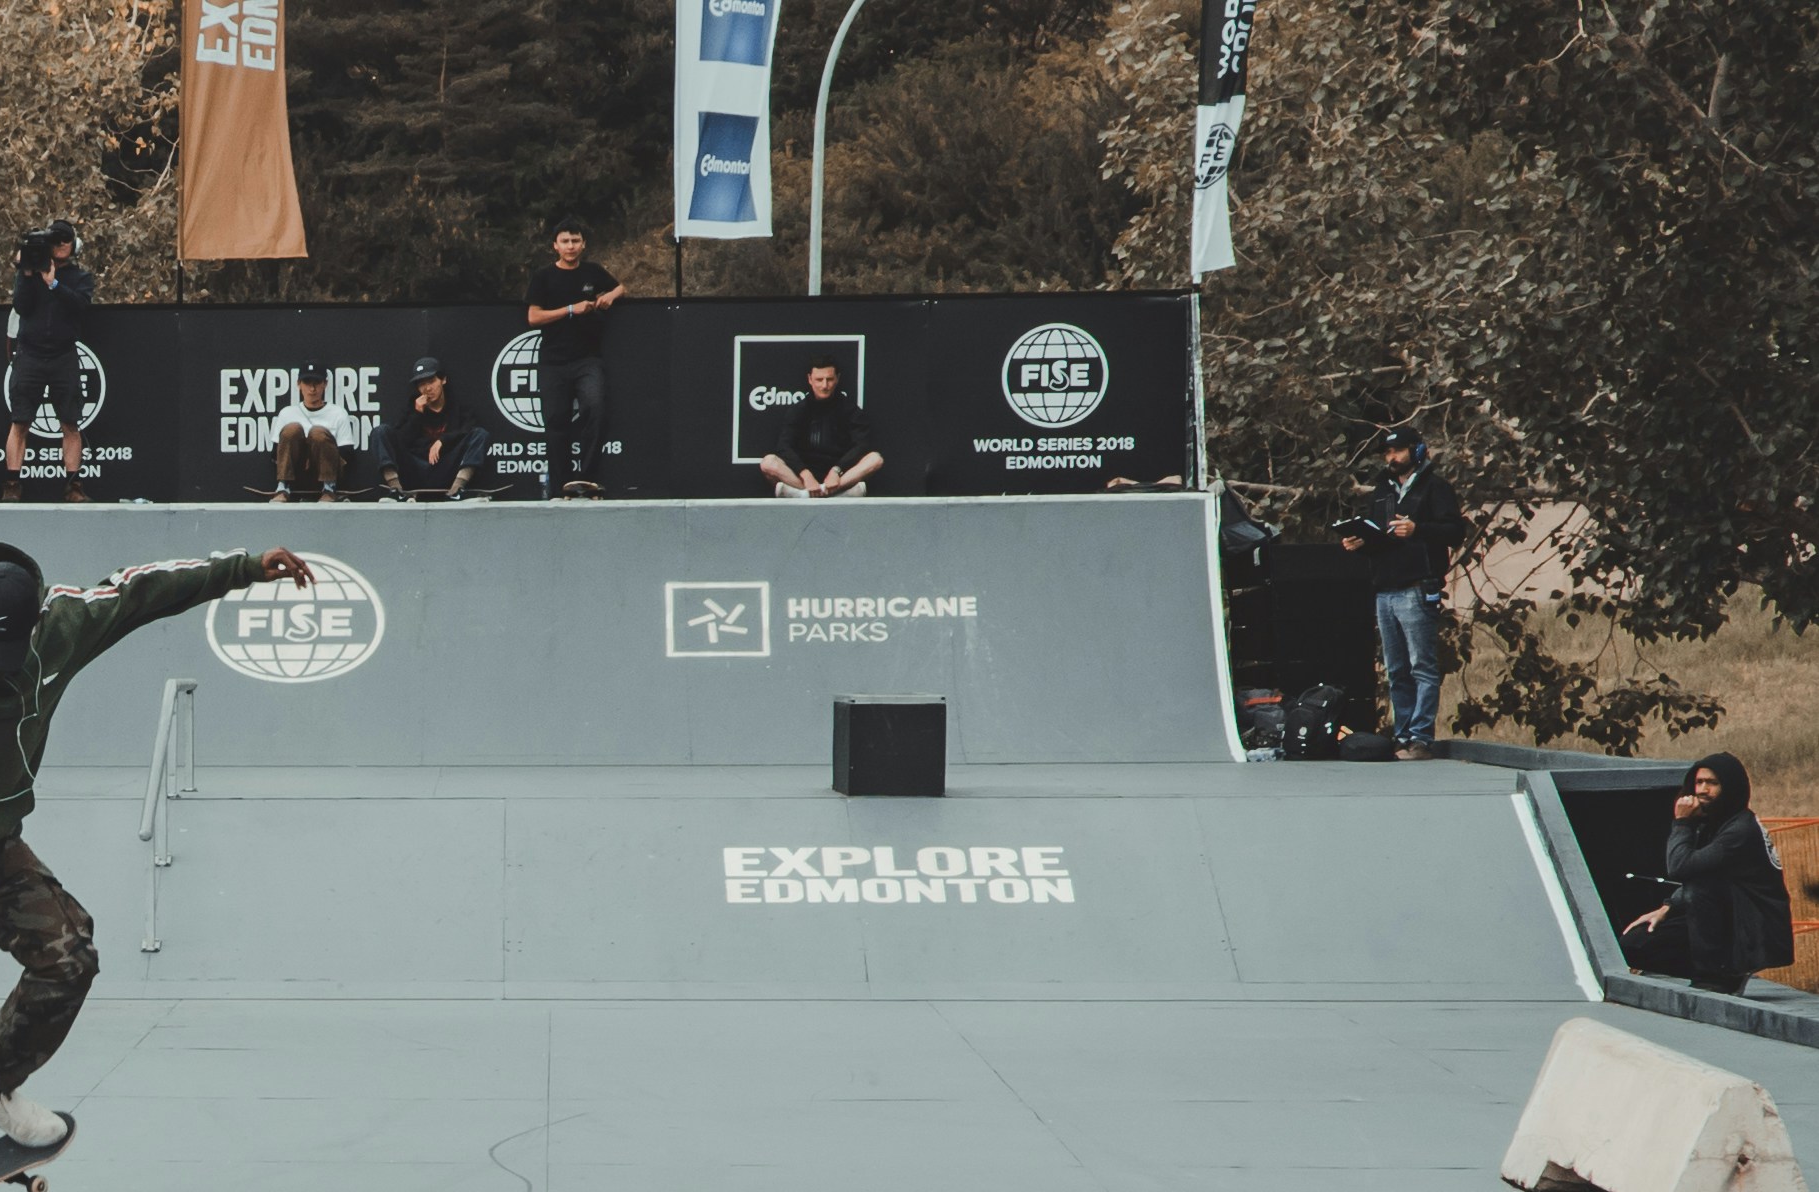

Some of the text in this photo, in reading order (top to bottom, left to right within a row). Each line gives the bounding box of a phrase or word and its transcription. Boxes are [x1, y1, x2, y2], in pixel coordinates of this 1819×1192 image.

[510, 369, 540, 392] FI
[1021, 360, 1090, 391] FISE
[96, 446, 132, 460] 2018
[973, 437, 1135, 452] WORLD SERIES 2018
[19, 465, 101, 479] DMONON
[1006, 455, 1102, 470] EDMONTON
[787, 597, 978, 619] HURRICANE
[238, 603, 353, 642] FISE
[789, 622, 889, 642] PARKS
[723, 846, 1069, 877] EXPLORE
[725, 878, 1075, 904] EDMONTON
